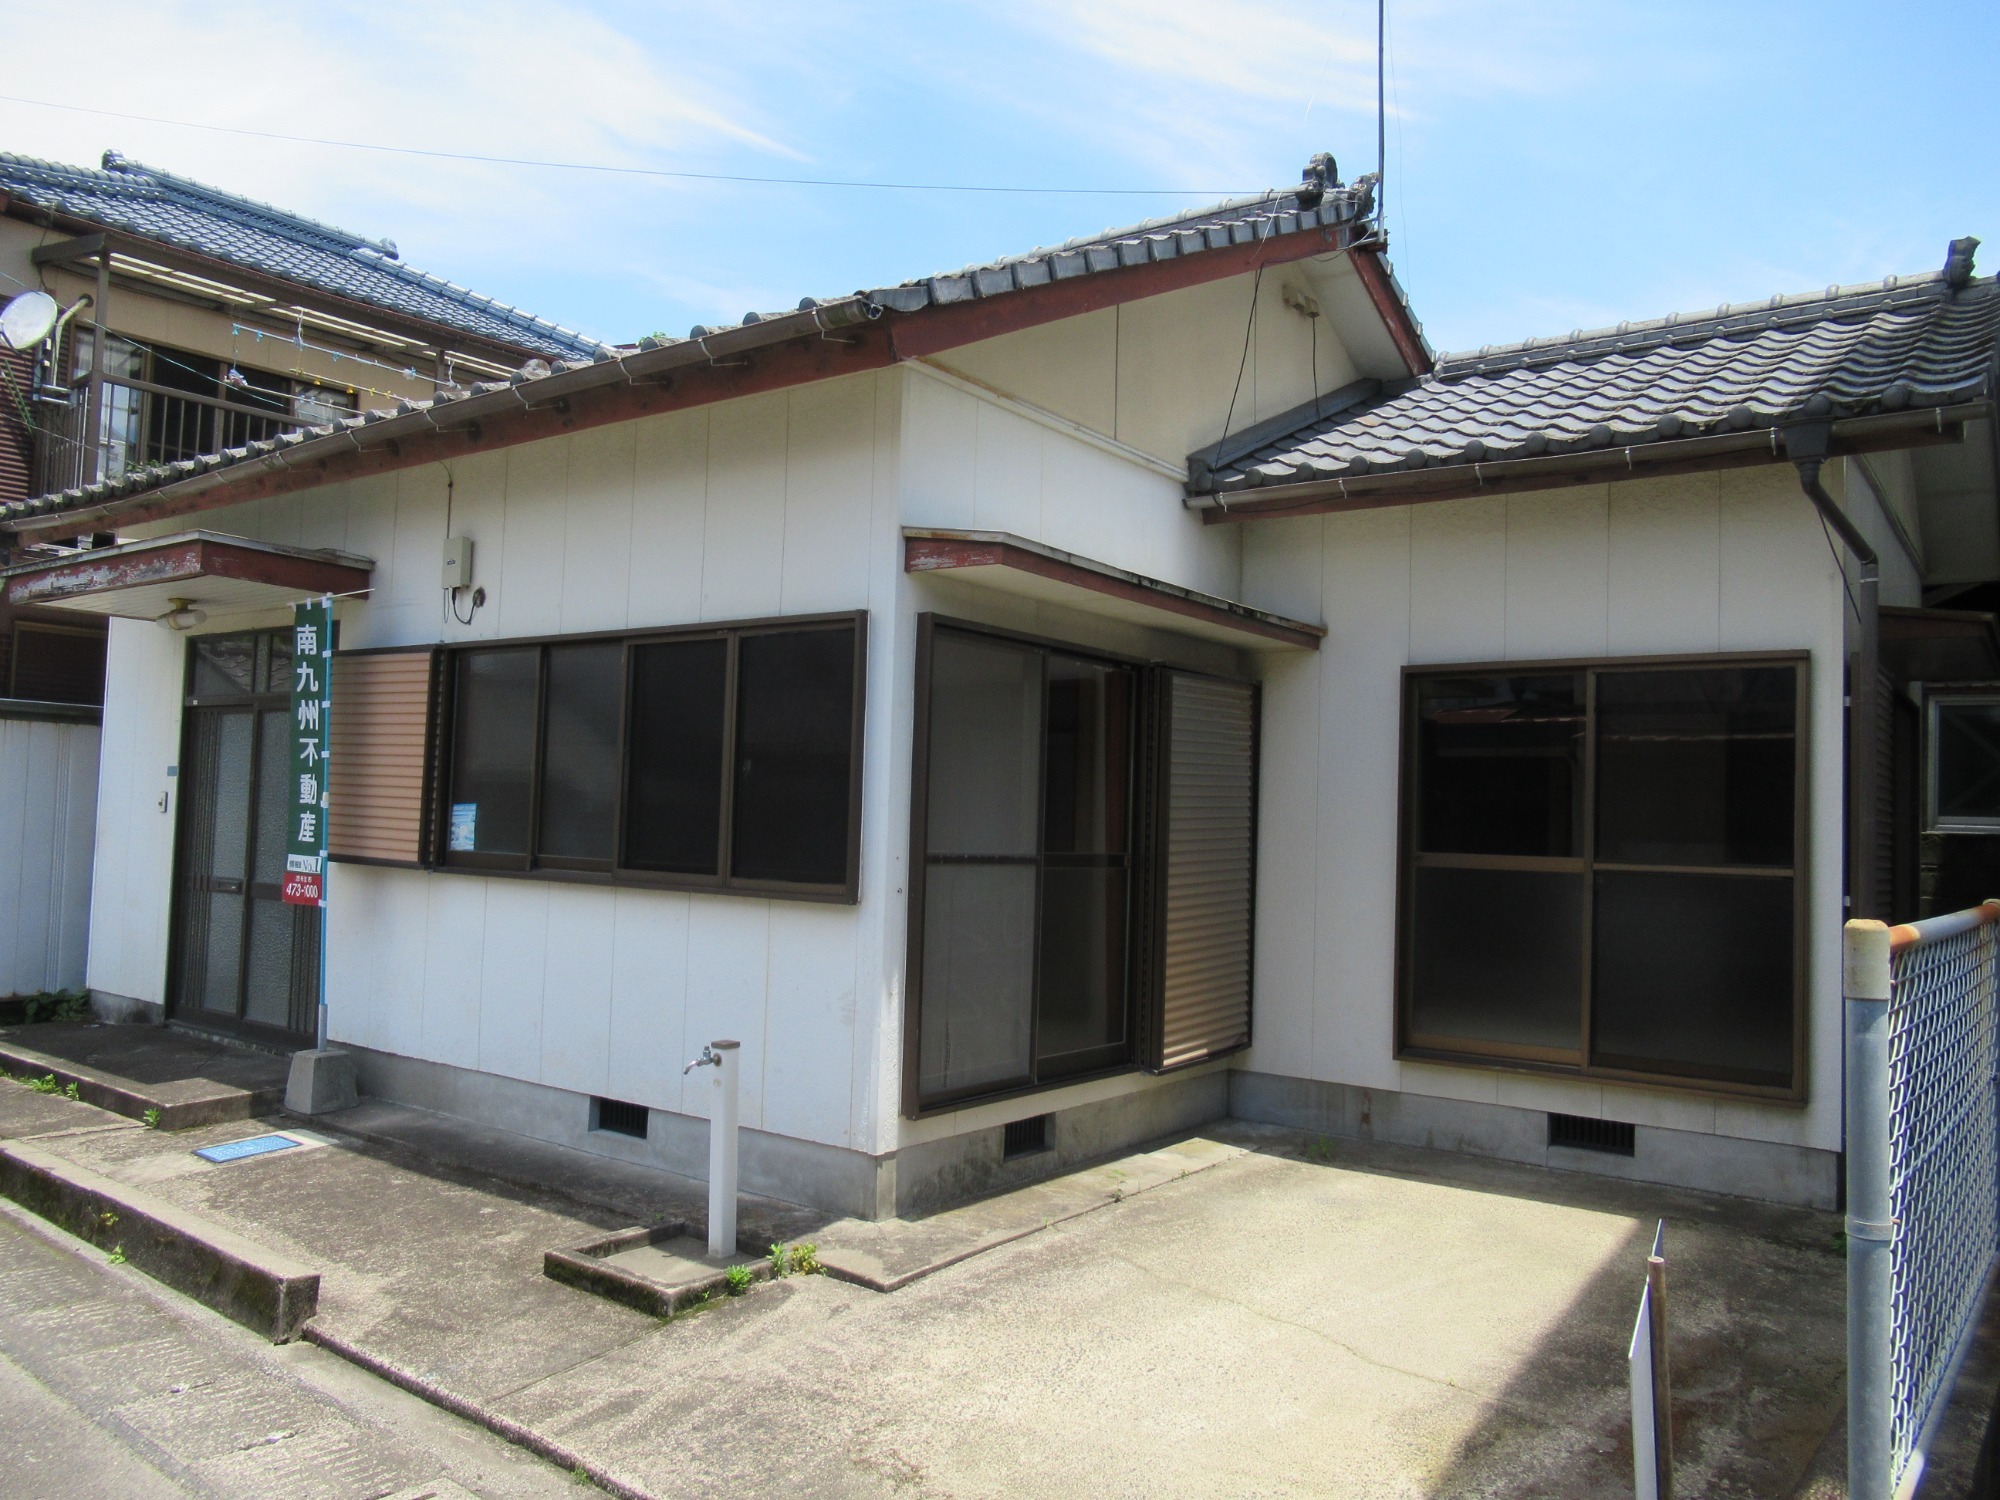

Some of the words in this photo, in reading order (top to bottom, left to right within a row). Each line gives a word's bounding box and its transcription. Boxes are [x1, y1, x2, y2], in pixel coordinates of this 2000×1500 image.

[296, 624, 319, 842] 南九州不動産
